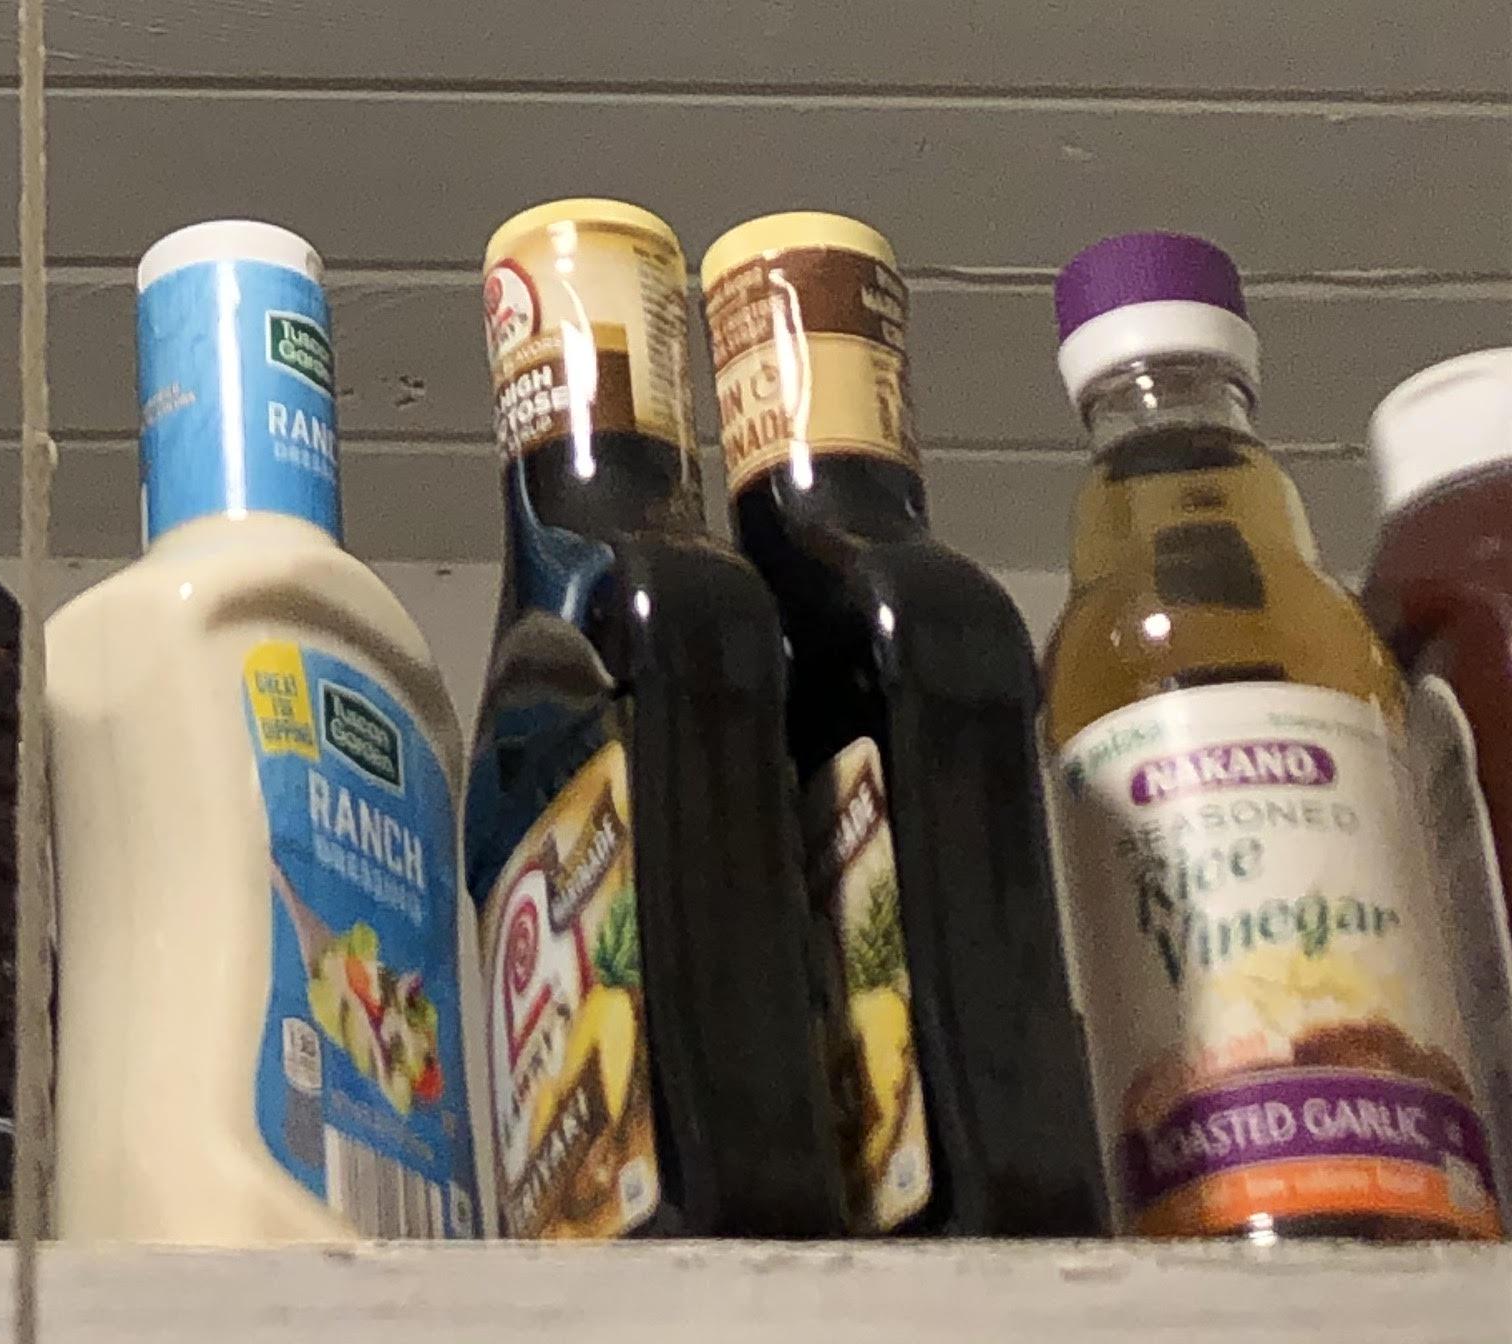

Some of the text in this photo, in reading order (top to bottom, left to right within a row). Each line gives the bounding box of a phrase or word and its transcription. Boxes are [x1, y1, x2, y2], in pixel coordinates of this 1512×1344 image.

[1144, 744, 1318, 798] NAKANO
[308, 768, 425, 892] RANCH
[1156, 893, 1401, 985] Vinegar
